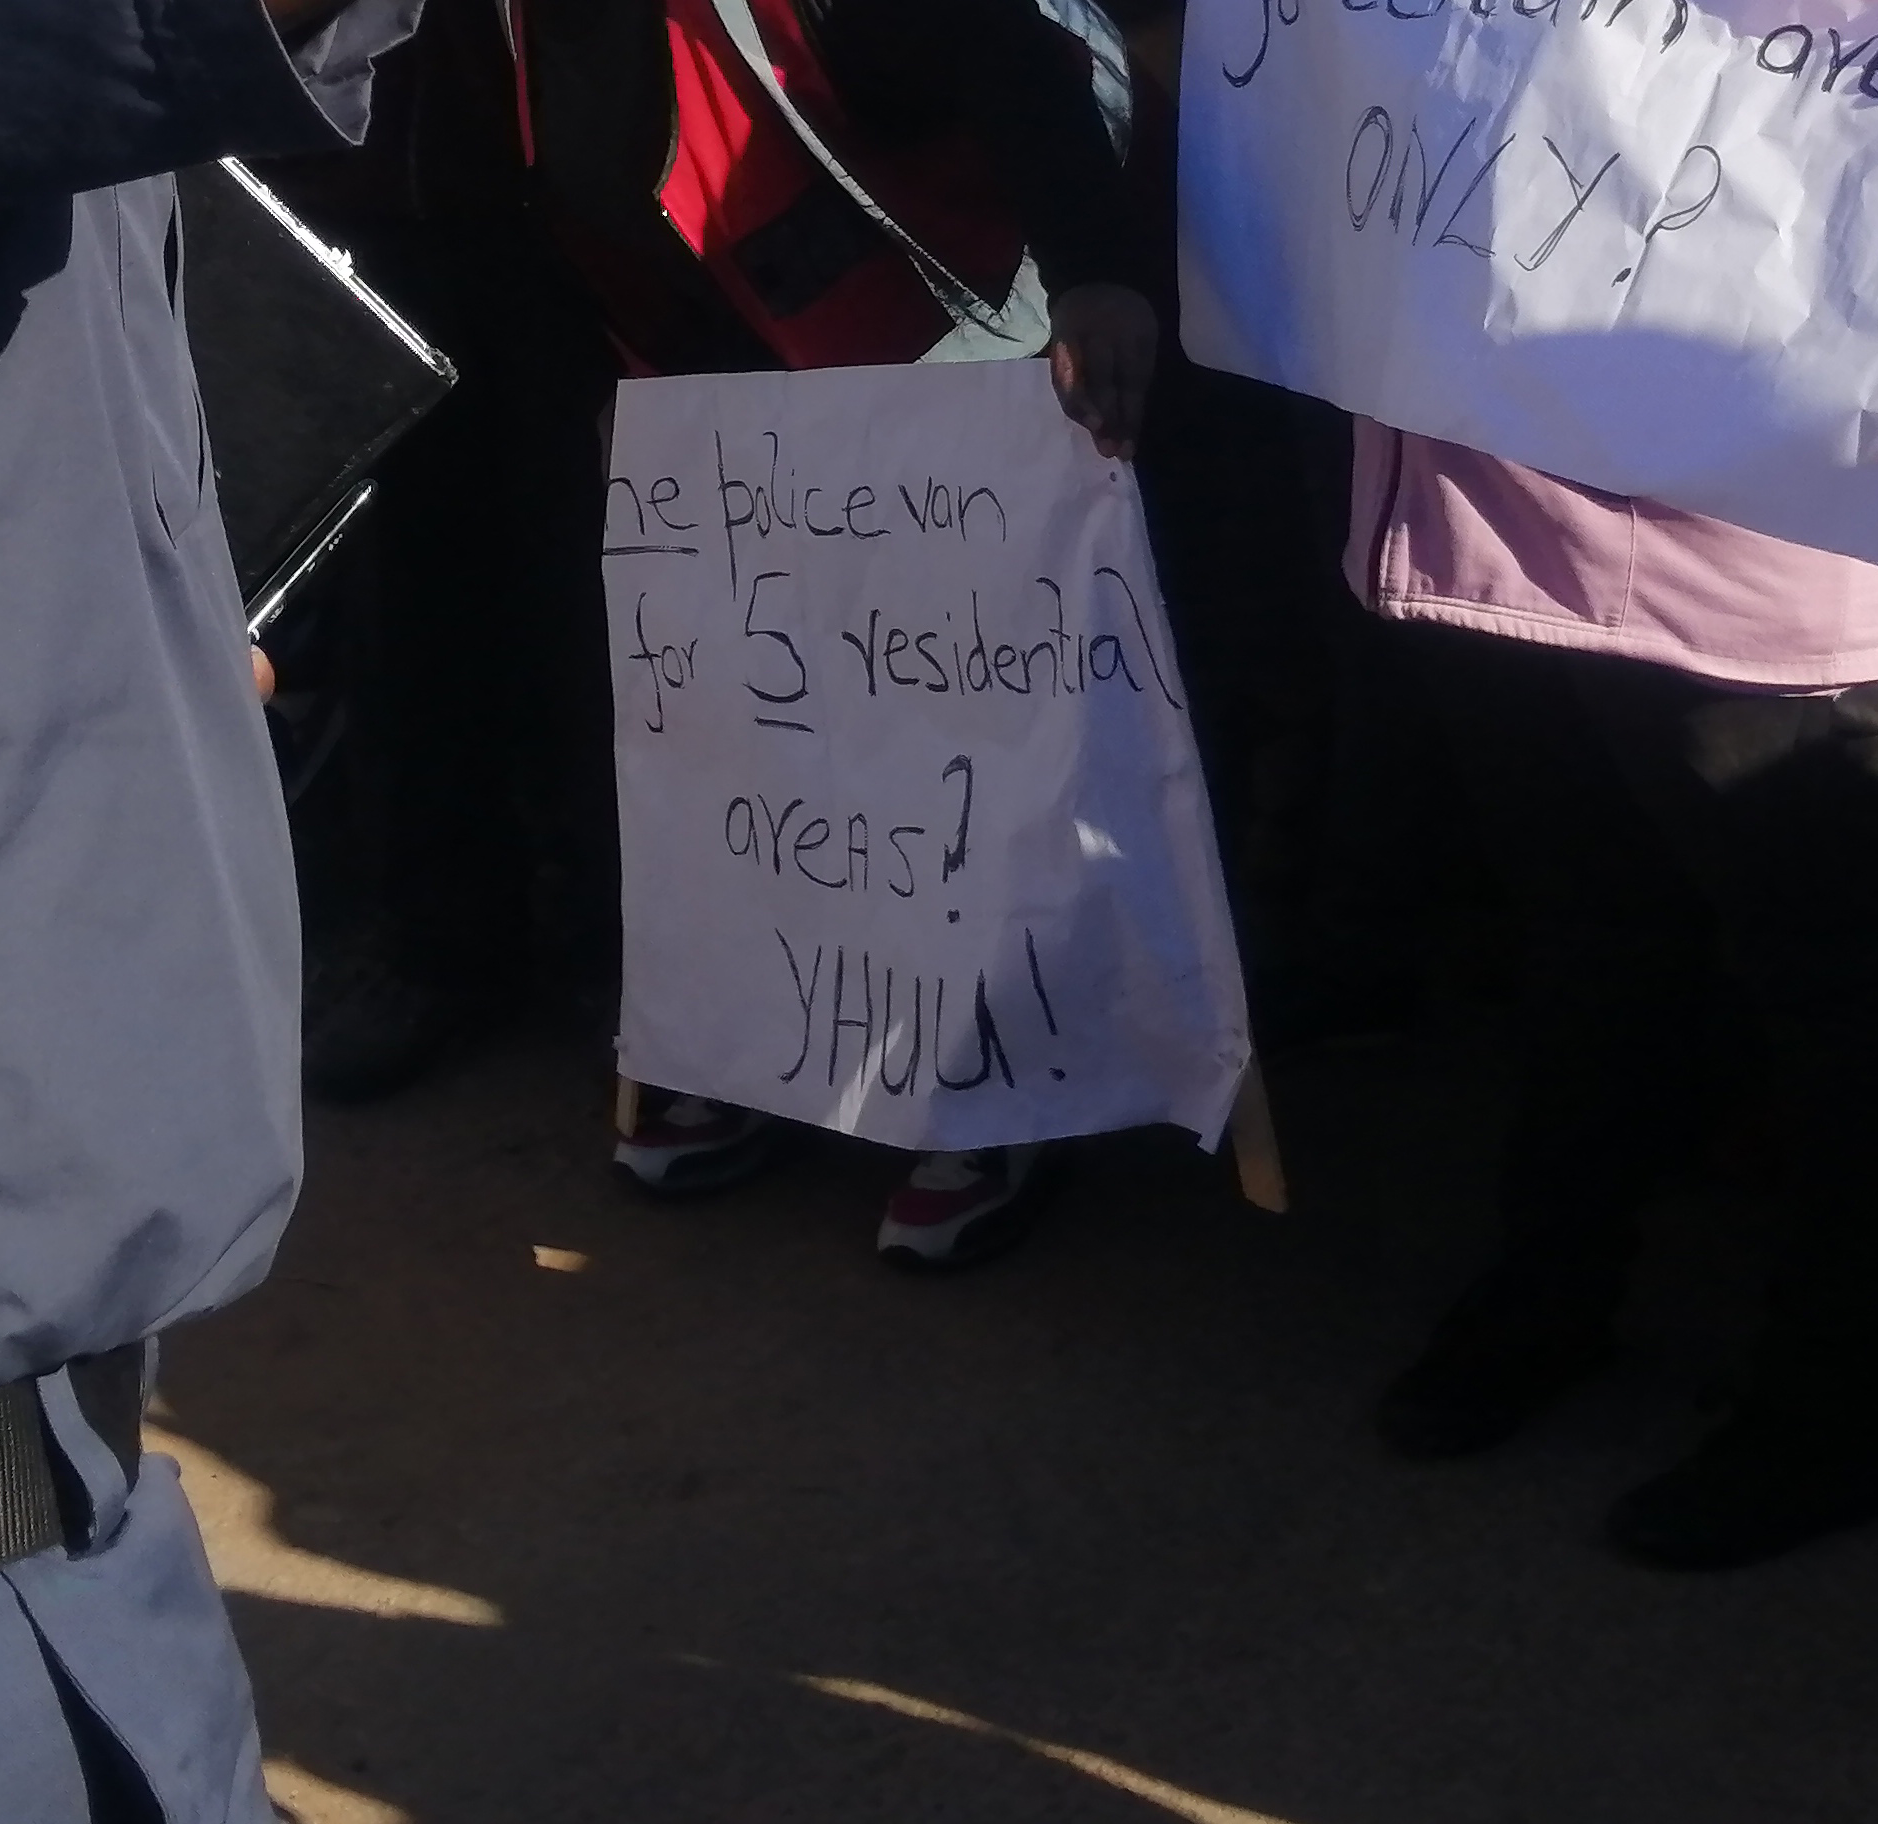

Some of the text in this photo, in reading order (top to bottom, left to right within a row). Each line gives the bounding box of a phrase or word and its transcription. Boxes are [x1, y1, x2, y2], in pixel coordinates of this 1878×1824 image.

[714, 430, 891, 602] police
[897, 475, 1009, 541] van
[627, 565, 1184, 734] for 5 residential
